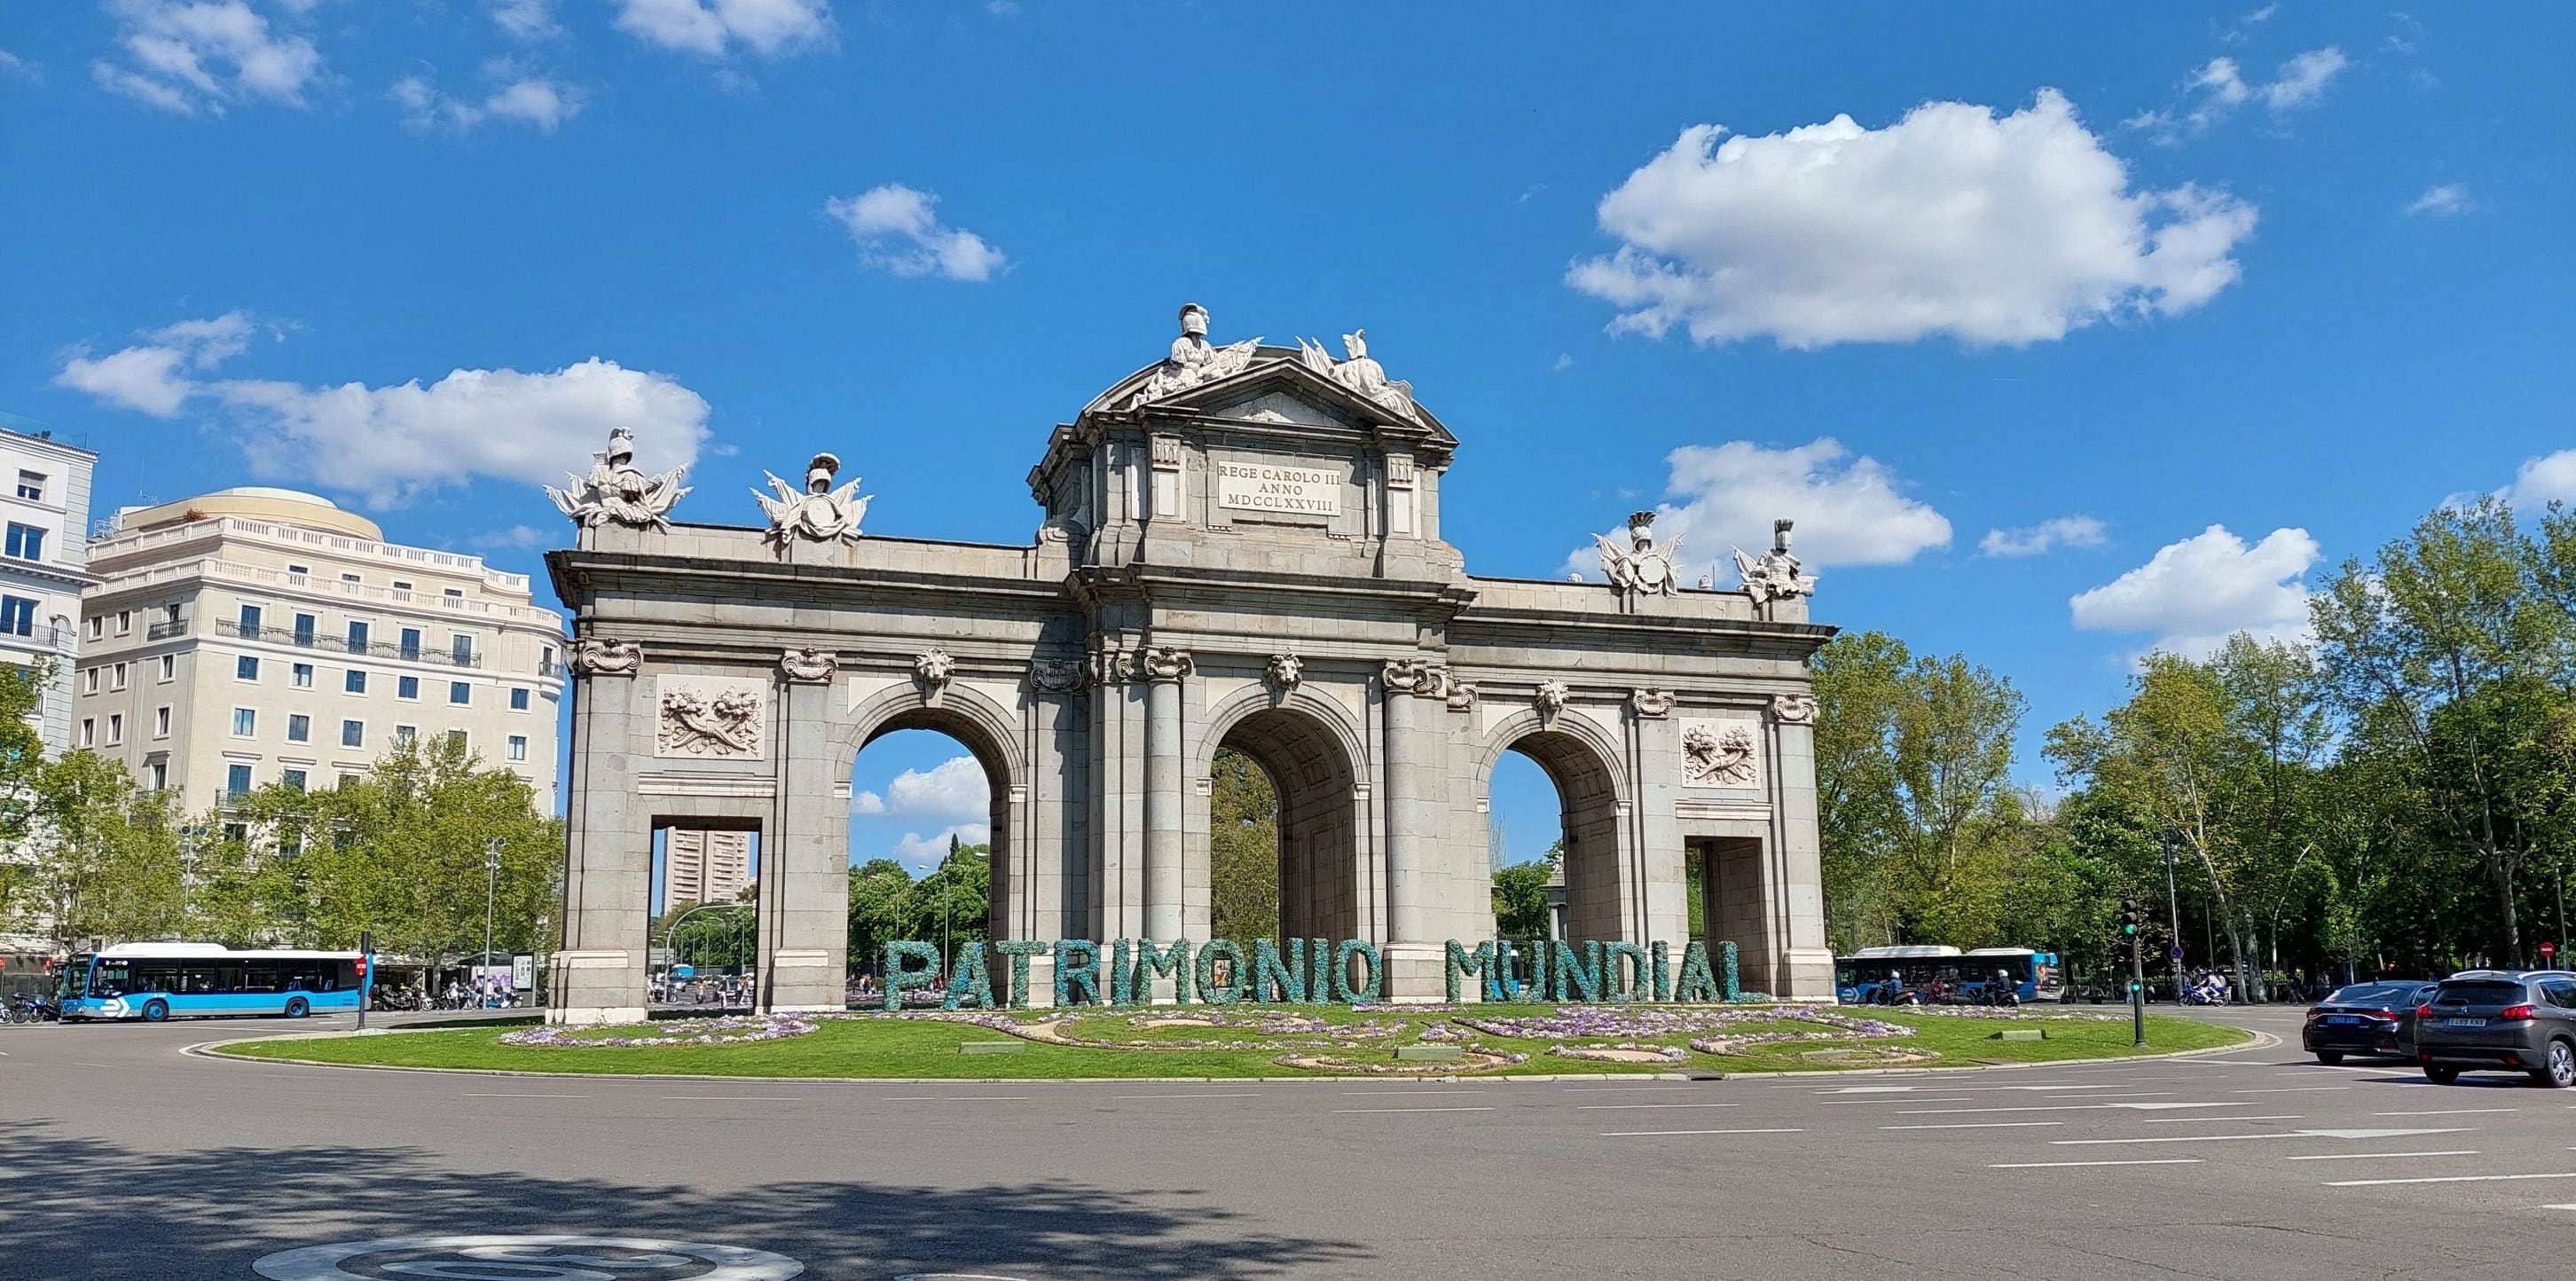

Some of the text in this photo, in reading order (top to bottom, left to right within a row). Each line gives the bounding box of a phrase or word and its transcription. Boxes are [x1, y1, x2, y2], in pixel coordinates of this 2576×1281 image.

[1219, 466, 1340, 485] REGE CAROLO III
[1259, 483, 1303, 495] ANNO
[1228, 494, 1333, 512] MDCCLXXVIII
[886, 938, 1773, 1011] PATRIMONIO MUNDIAL
